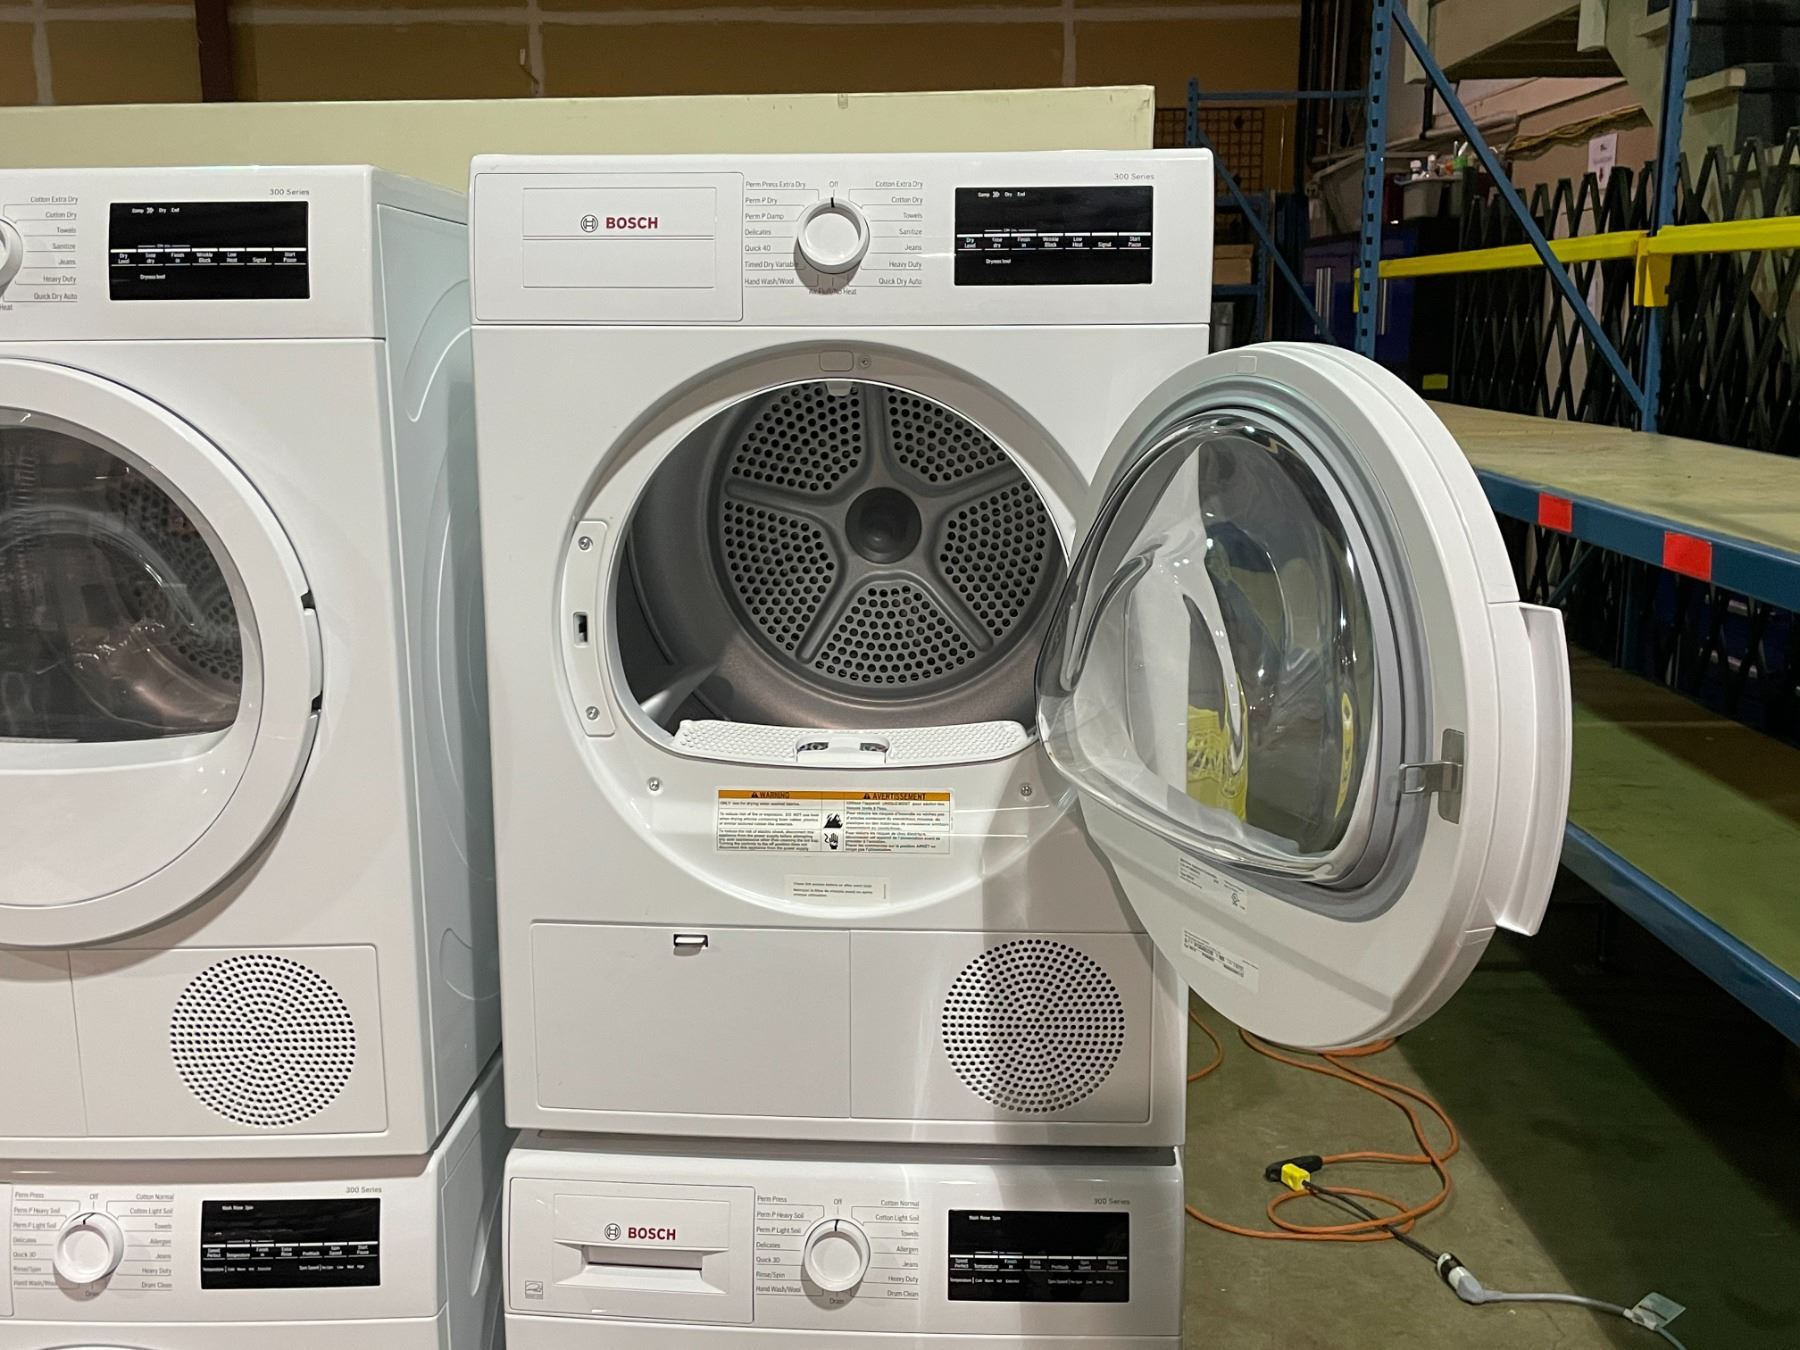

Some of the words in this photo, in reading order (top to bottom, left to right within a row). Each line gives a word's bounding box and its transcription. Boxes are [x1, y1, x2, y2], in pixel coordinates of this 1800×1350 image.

[1114, 173, 1129, 181] 300
[795, 181, 805, 190] Dry
[829, 180, 838, 188] Off
[912, 180, 923, 189] Dry
[68, 196, 78, 204] Dry
[767, 197, 777, 205] Dry
[912, 197, 923, 205] Dry
[67, 211, 77, 219] Dry
[606, 217, 658, 229] BOSCH
[764, 261, 774, 269] Dry
[889, 261, 906, 269] Heavy
[43, 275, 61, 283] Heavy
[896, 278, 907, 287] Dry
[52, 293, 63, 301] Dry
[777, 1212, 794, 1220] Heavy
[628, 1228, 676, 1240] BOSCH
[776, 1227, 790, 1235] Light
